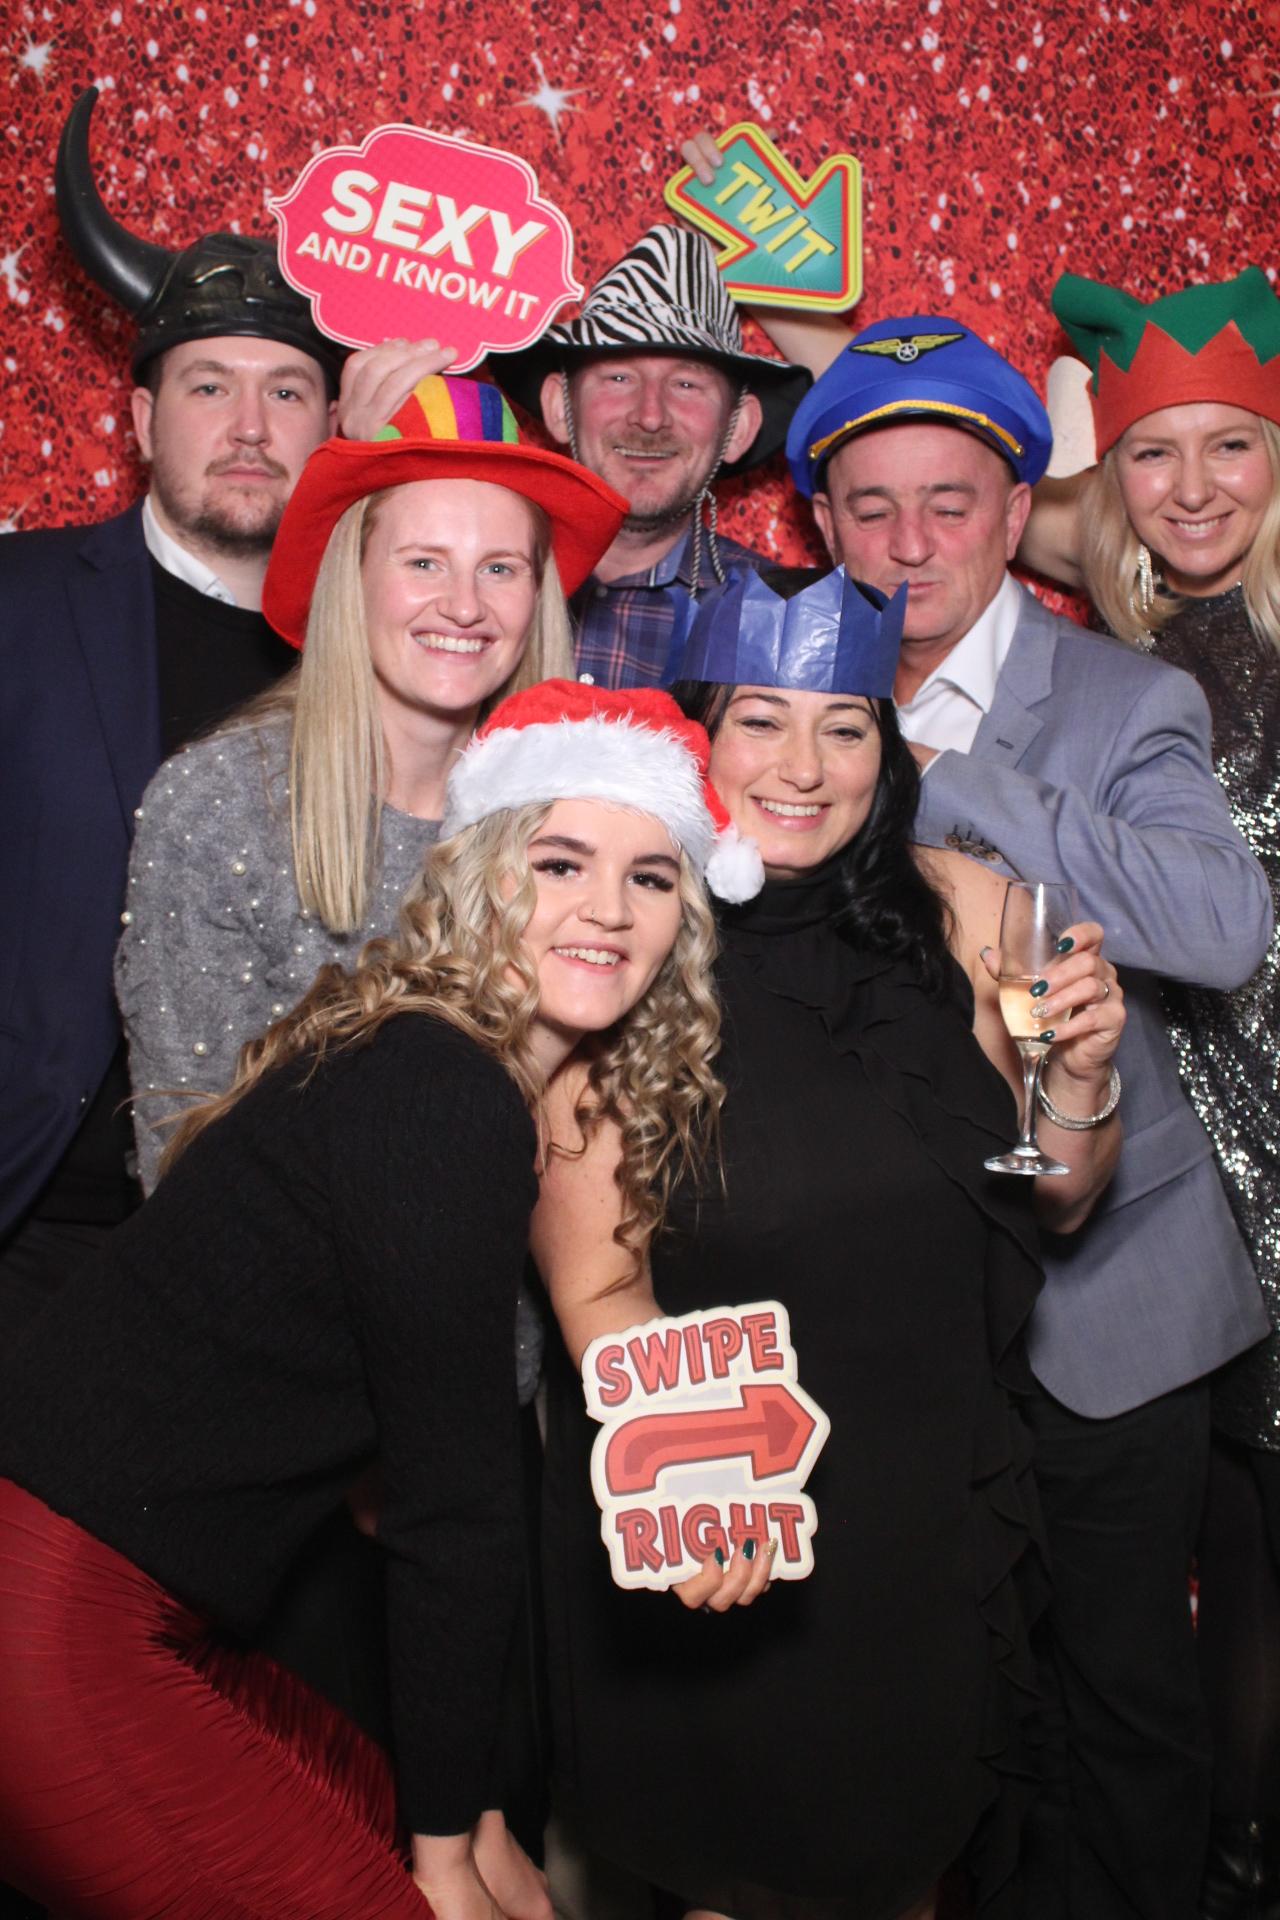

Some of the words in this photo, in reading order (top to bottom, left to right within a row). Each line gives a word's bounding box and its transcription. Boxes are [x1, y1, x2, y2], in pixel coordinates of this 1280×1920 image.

[321, 169, 549, 279] SEXY
[714, 161, 837, 273] TWIT
[296, 232, 372, 272] AND
[376, 253, 390, 279] I
[393, 257, 505, 311] KNOW
[504, 290, 540, 320] IT
[595, 1312, 784, 1407] SWIPE
[615, 1502, 805, 1573] RIGHT
